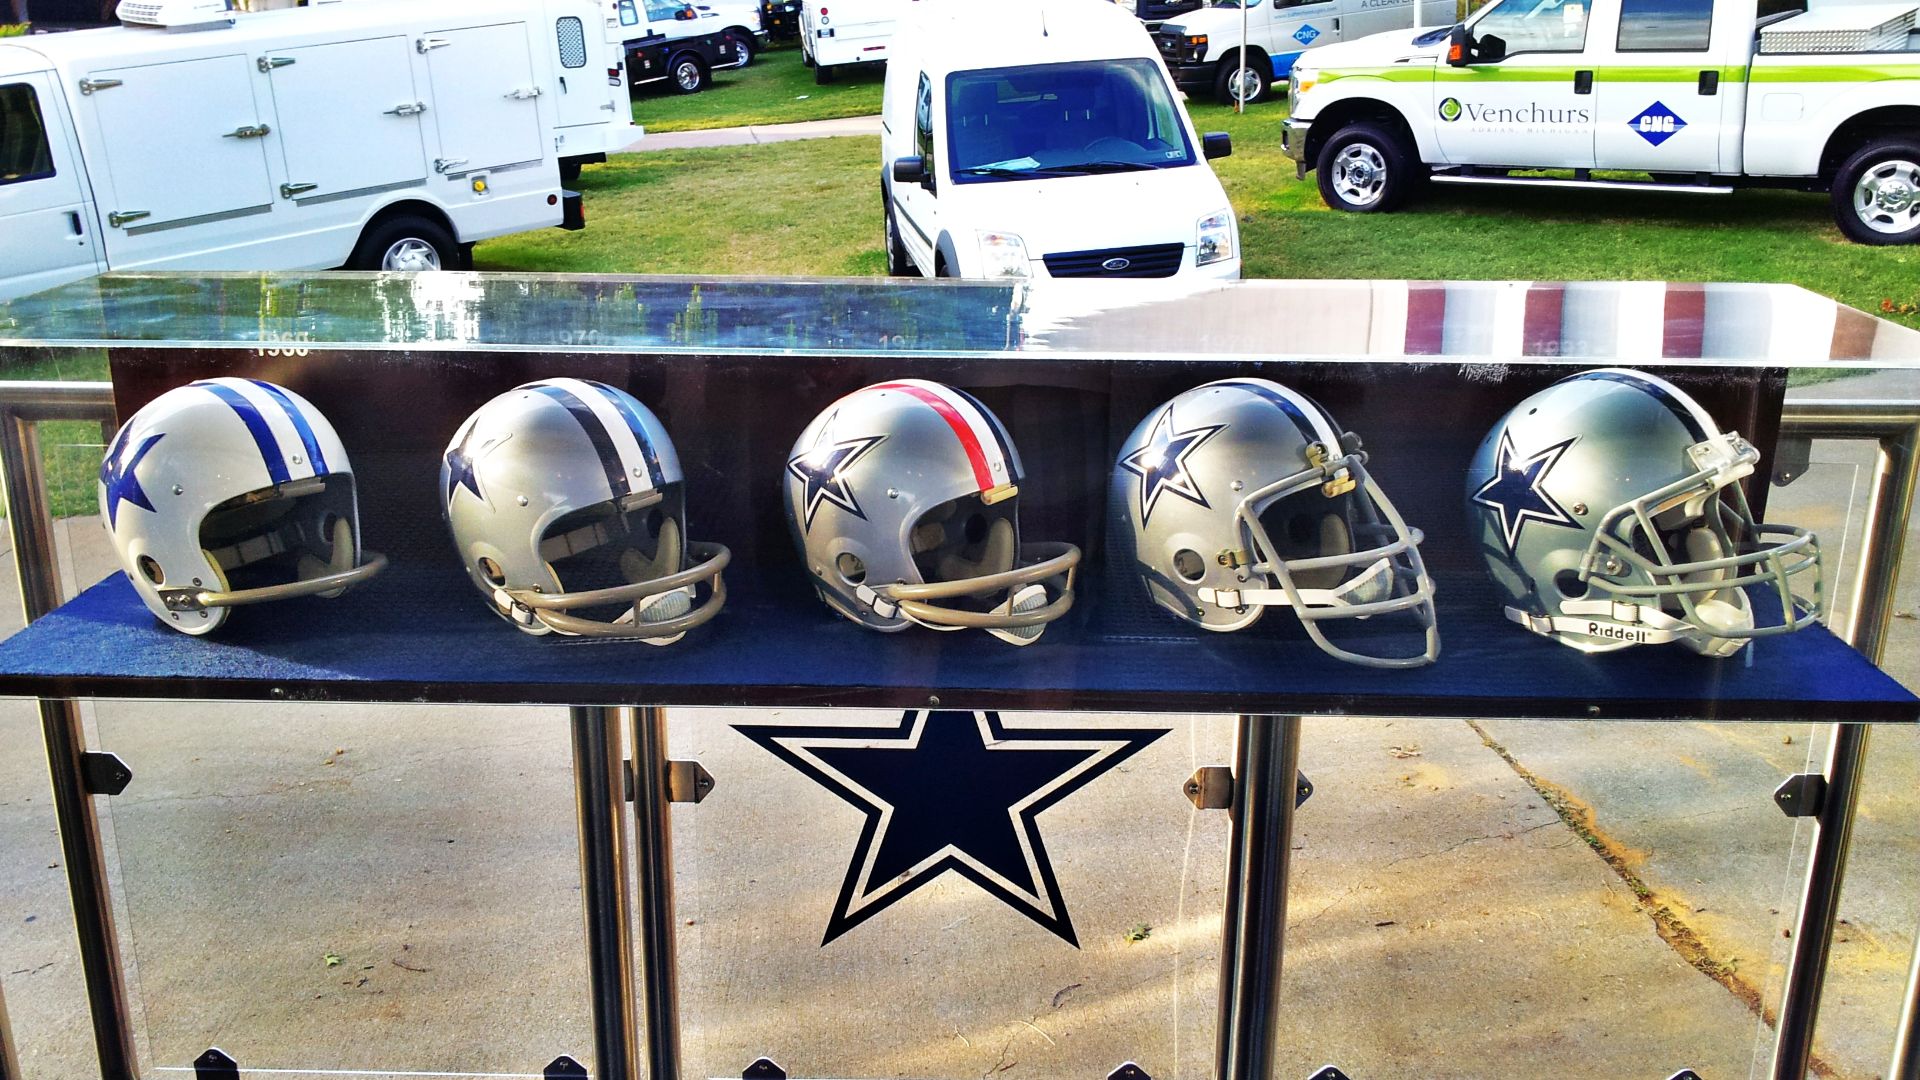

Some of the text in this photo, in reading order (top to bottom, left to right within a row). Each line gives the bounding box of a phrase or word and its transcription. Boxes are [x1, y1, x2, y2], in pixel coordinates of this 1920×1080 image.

[1369, 0, 1414, 8] CLEAN
[1295, 30, 1317, 40] CNG
[1465, 102, 1589, 124] Venchurs
[1639, 115, 1675, 133] CNG
[257, 331, 309, 357] 1960
[1589, 622, 1646, 642] Riddell
